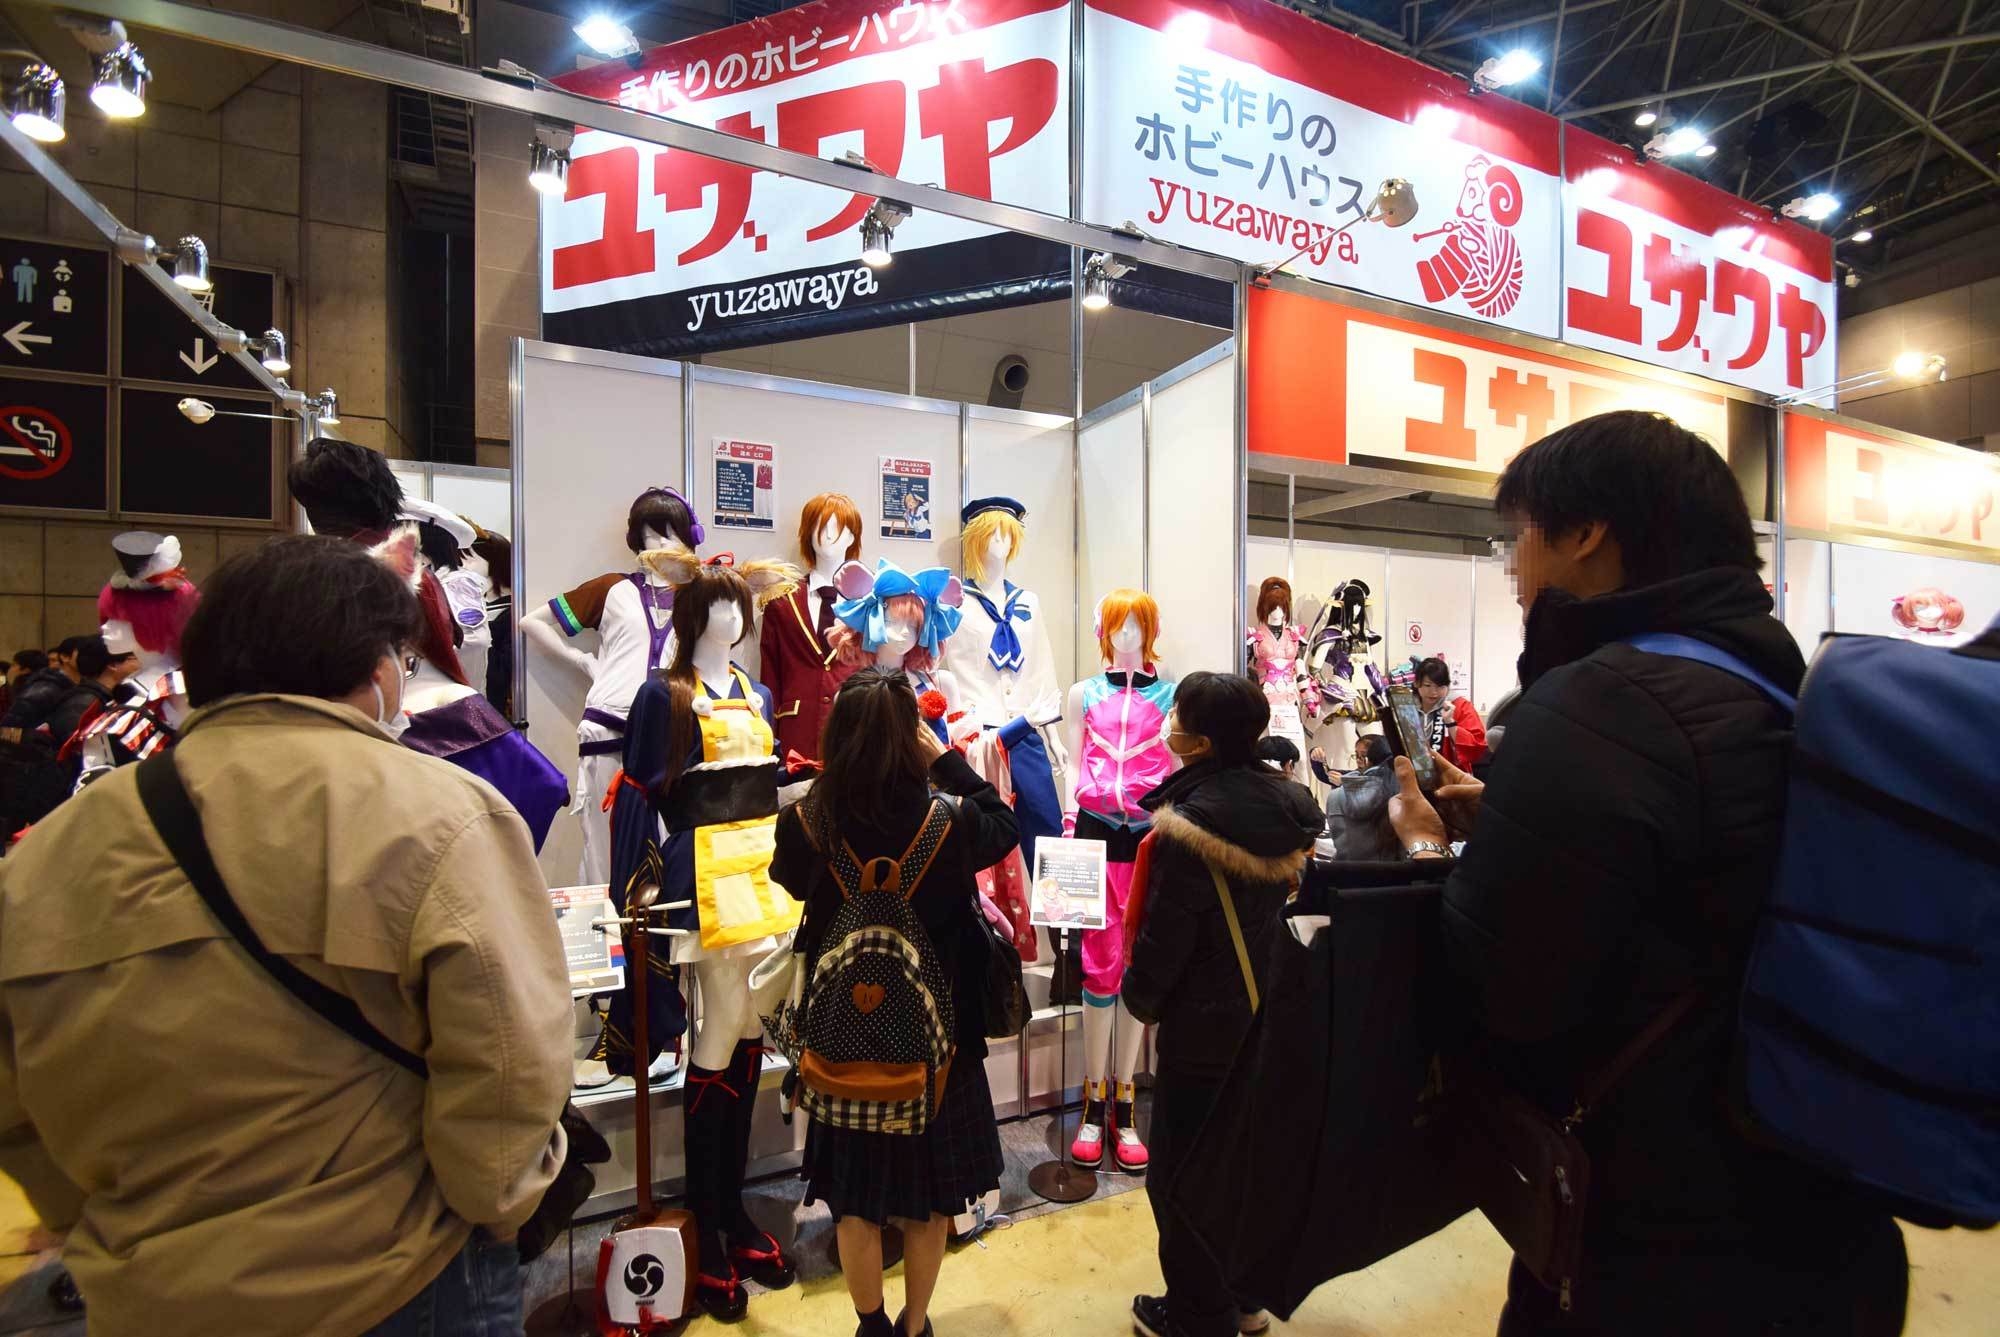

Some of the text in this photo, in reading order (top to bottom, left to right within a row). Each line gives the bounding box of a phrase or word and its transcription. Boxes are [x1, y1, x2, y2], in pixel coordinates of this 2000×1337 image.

[617, 0, 969, 111] 手作りのホビーハウス
[1174, 64, 1337, 157] 手作りの
[552, 56, 1059, 290] ユザワヤ
[1133, 111, 1367, 218] ホビーハウス
[1146, 176, 1360, 267] yuzawaya
[686, 265, 878, 332] yuzawaya
[1567, 207, 1826, 389] ユザワヤ
